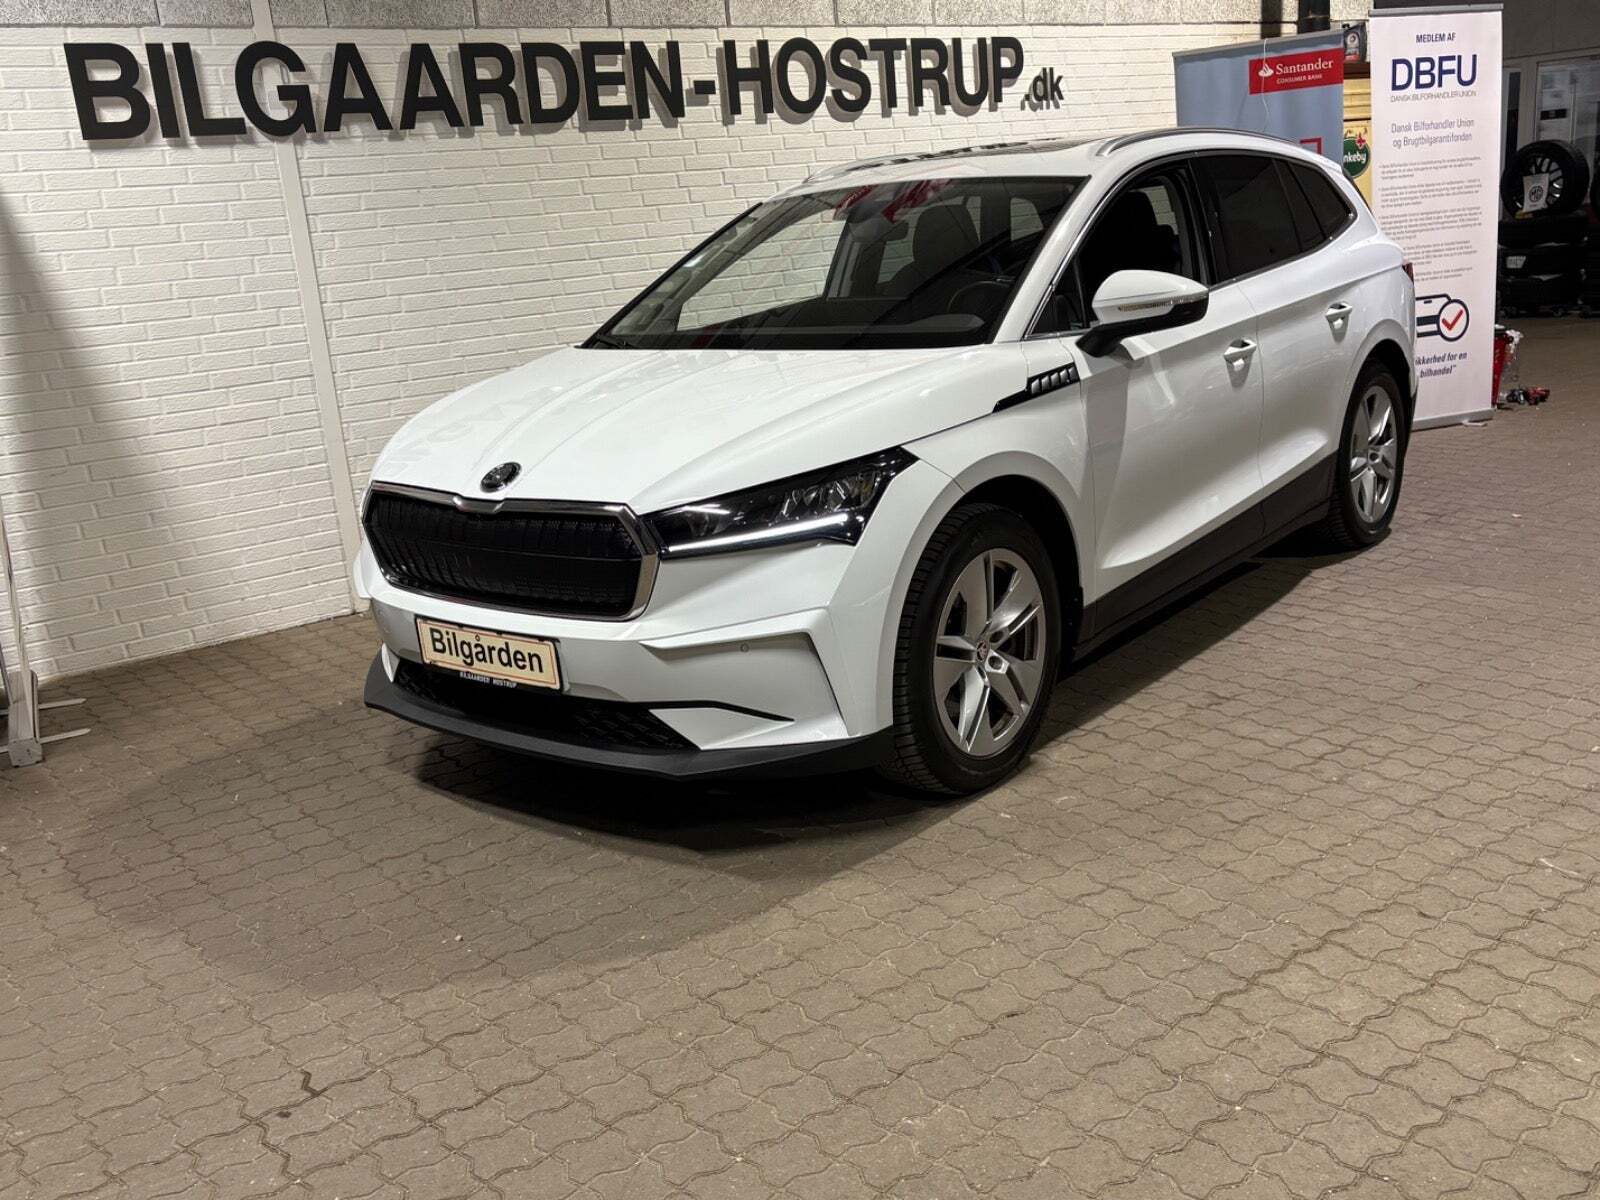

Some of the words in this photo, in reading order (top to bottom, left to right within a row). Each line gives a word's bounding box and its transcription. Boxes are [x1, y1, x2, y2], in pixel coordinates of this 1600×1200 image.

[1416, 33, 1446, 43] MEDLEM
[1447, 32, 1456, 41] AF
[1276, 58, 1334, 75] Santander
[1391, 54, 1478, 91] DBFU
[1276, 76, 1307, 84] CONSUMER
[1391, 123, 1412, 133] Dansk
[1413, 120, 1455, 132] Bilforhandler
[1456, 118, 1475, 128] Union
[1392, 139, 1402, 149] og
[1415, 352, 1447, 366] ikkerhed
[1447, 351, 1458, 361] for
[1458, 352, 1467, 360] en
[429, 627, 544, 673] Bilgården
